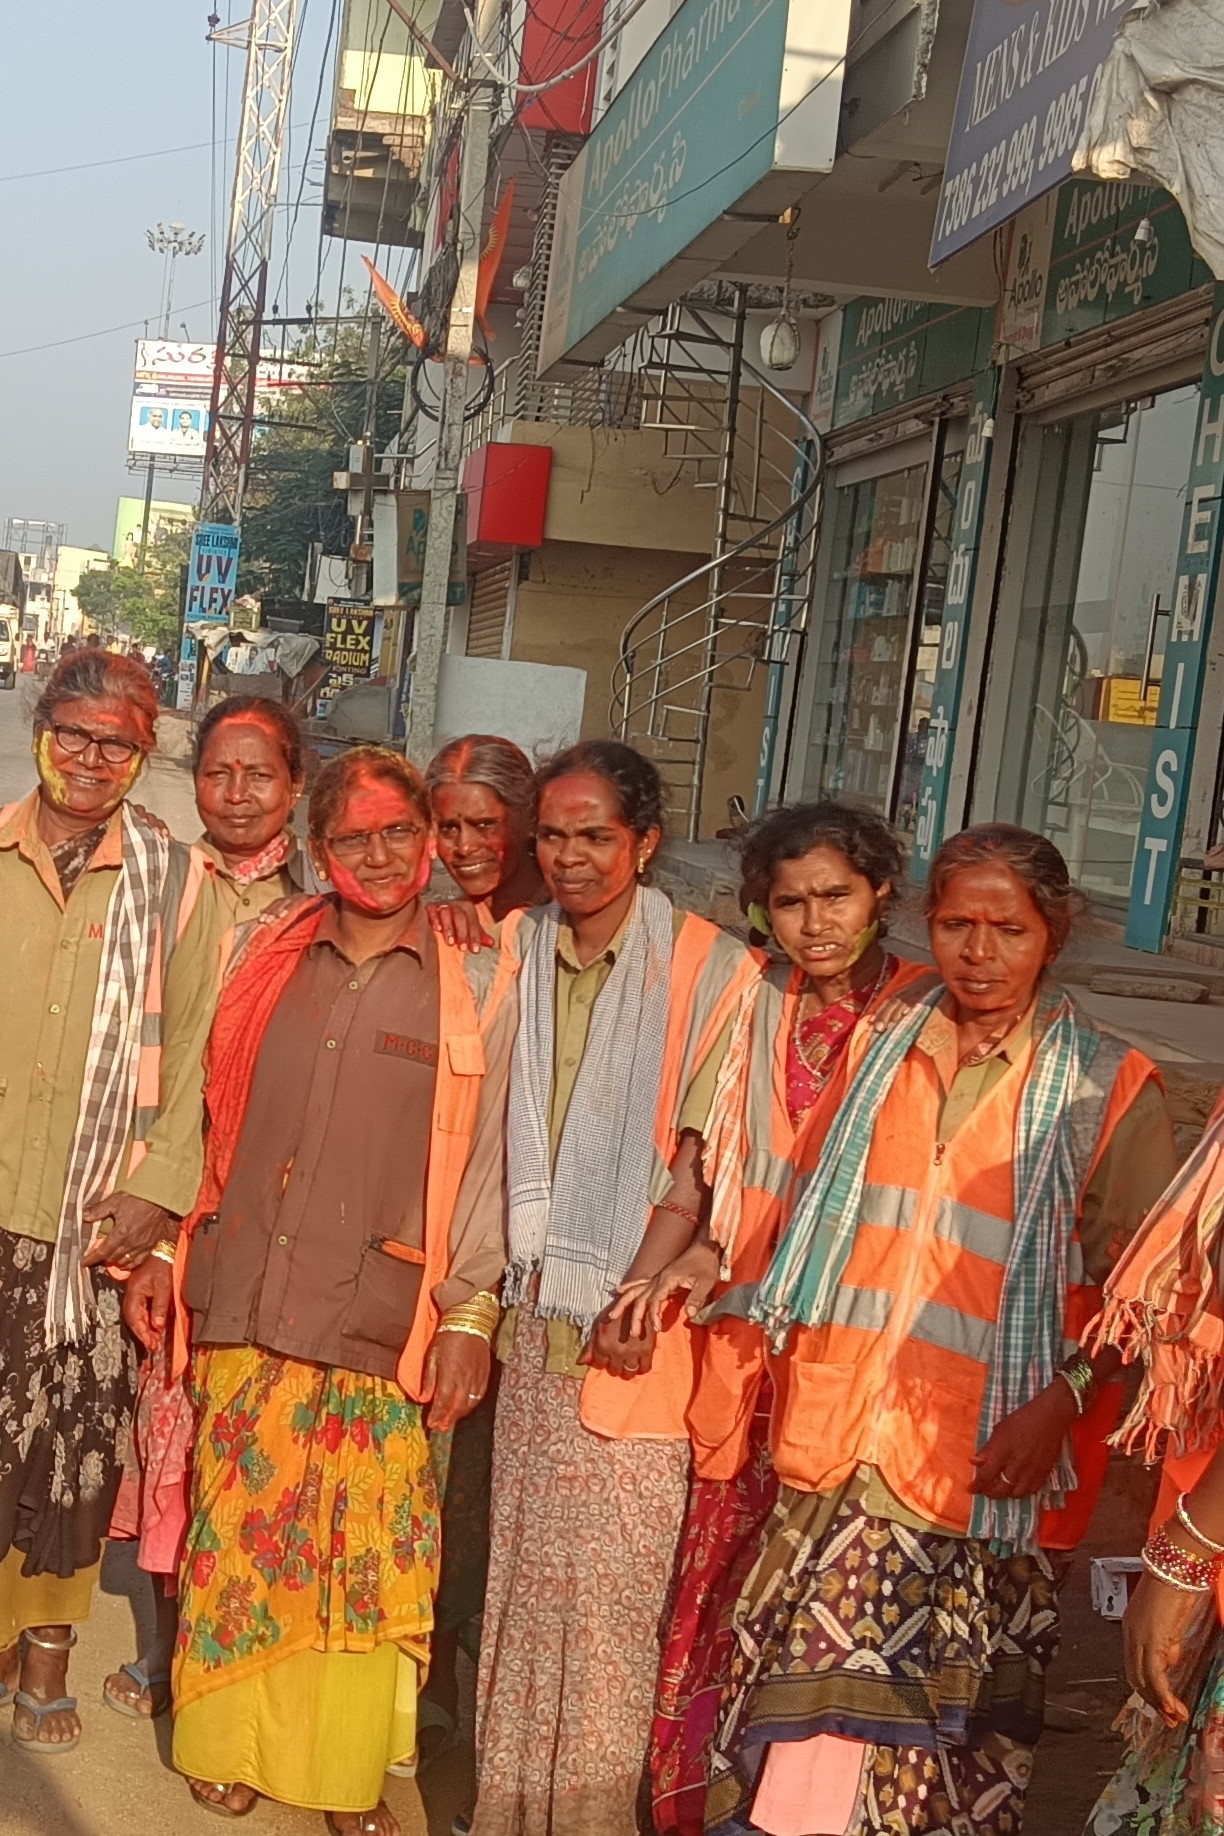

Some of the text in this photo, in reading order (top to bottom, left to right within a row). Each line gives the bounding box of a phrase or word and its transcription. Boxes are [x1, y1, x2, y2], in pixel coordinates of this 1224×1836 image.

[1020, 10, 1041, 89] &
[938, 161, 978, 242] 7386
[972, 139, 1007, 219] 232
[1039, 74, 1089, 171] 9985
[196, 554, 234, 584] UV
[188, 585, 233, 615] FLEX
[331, 617, 368, 634] UV
[325, 633, 371, 650] FLEX
[325, 649, 370, 667] RADIUM
